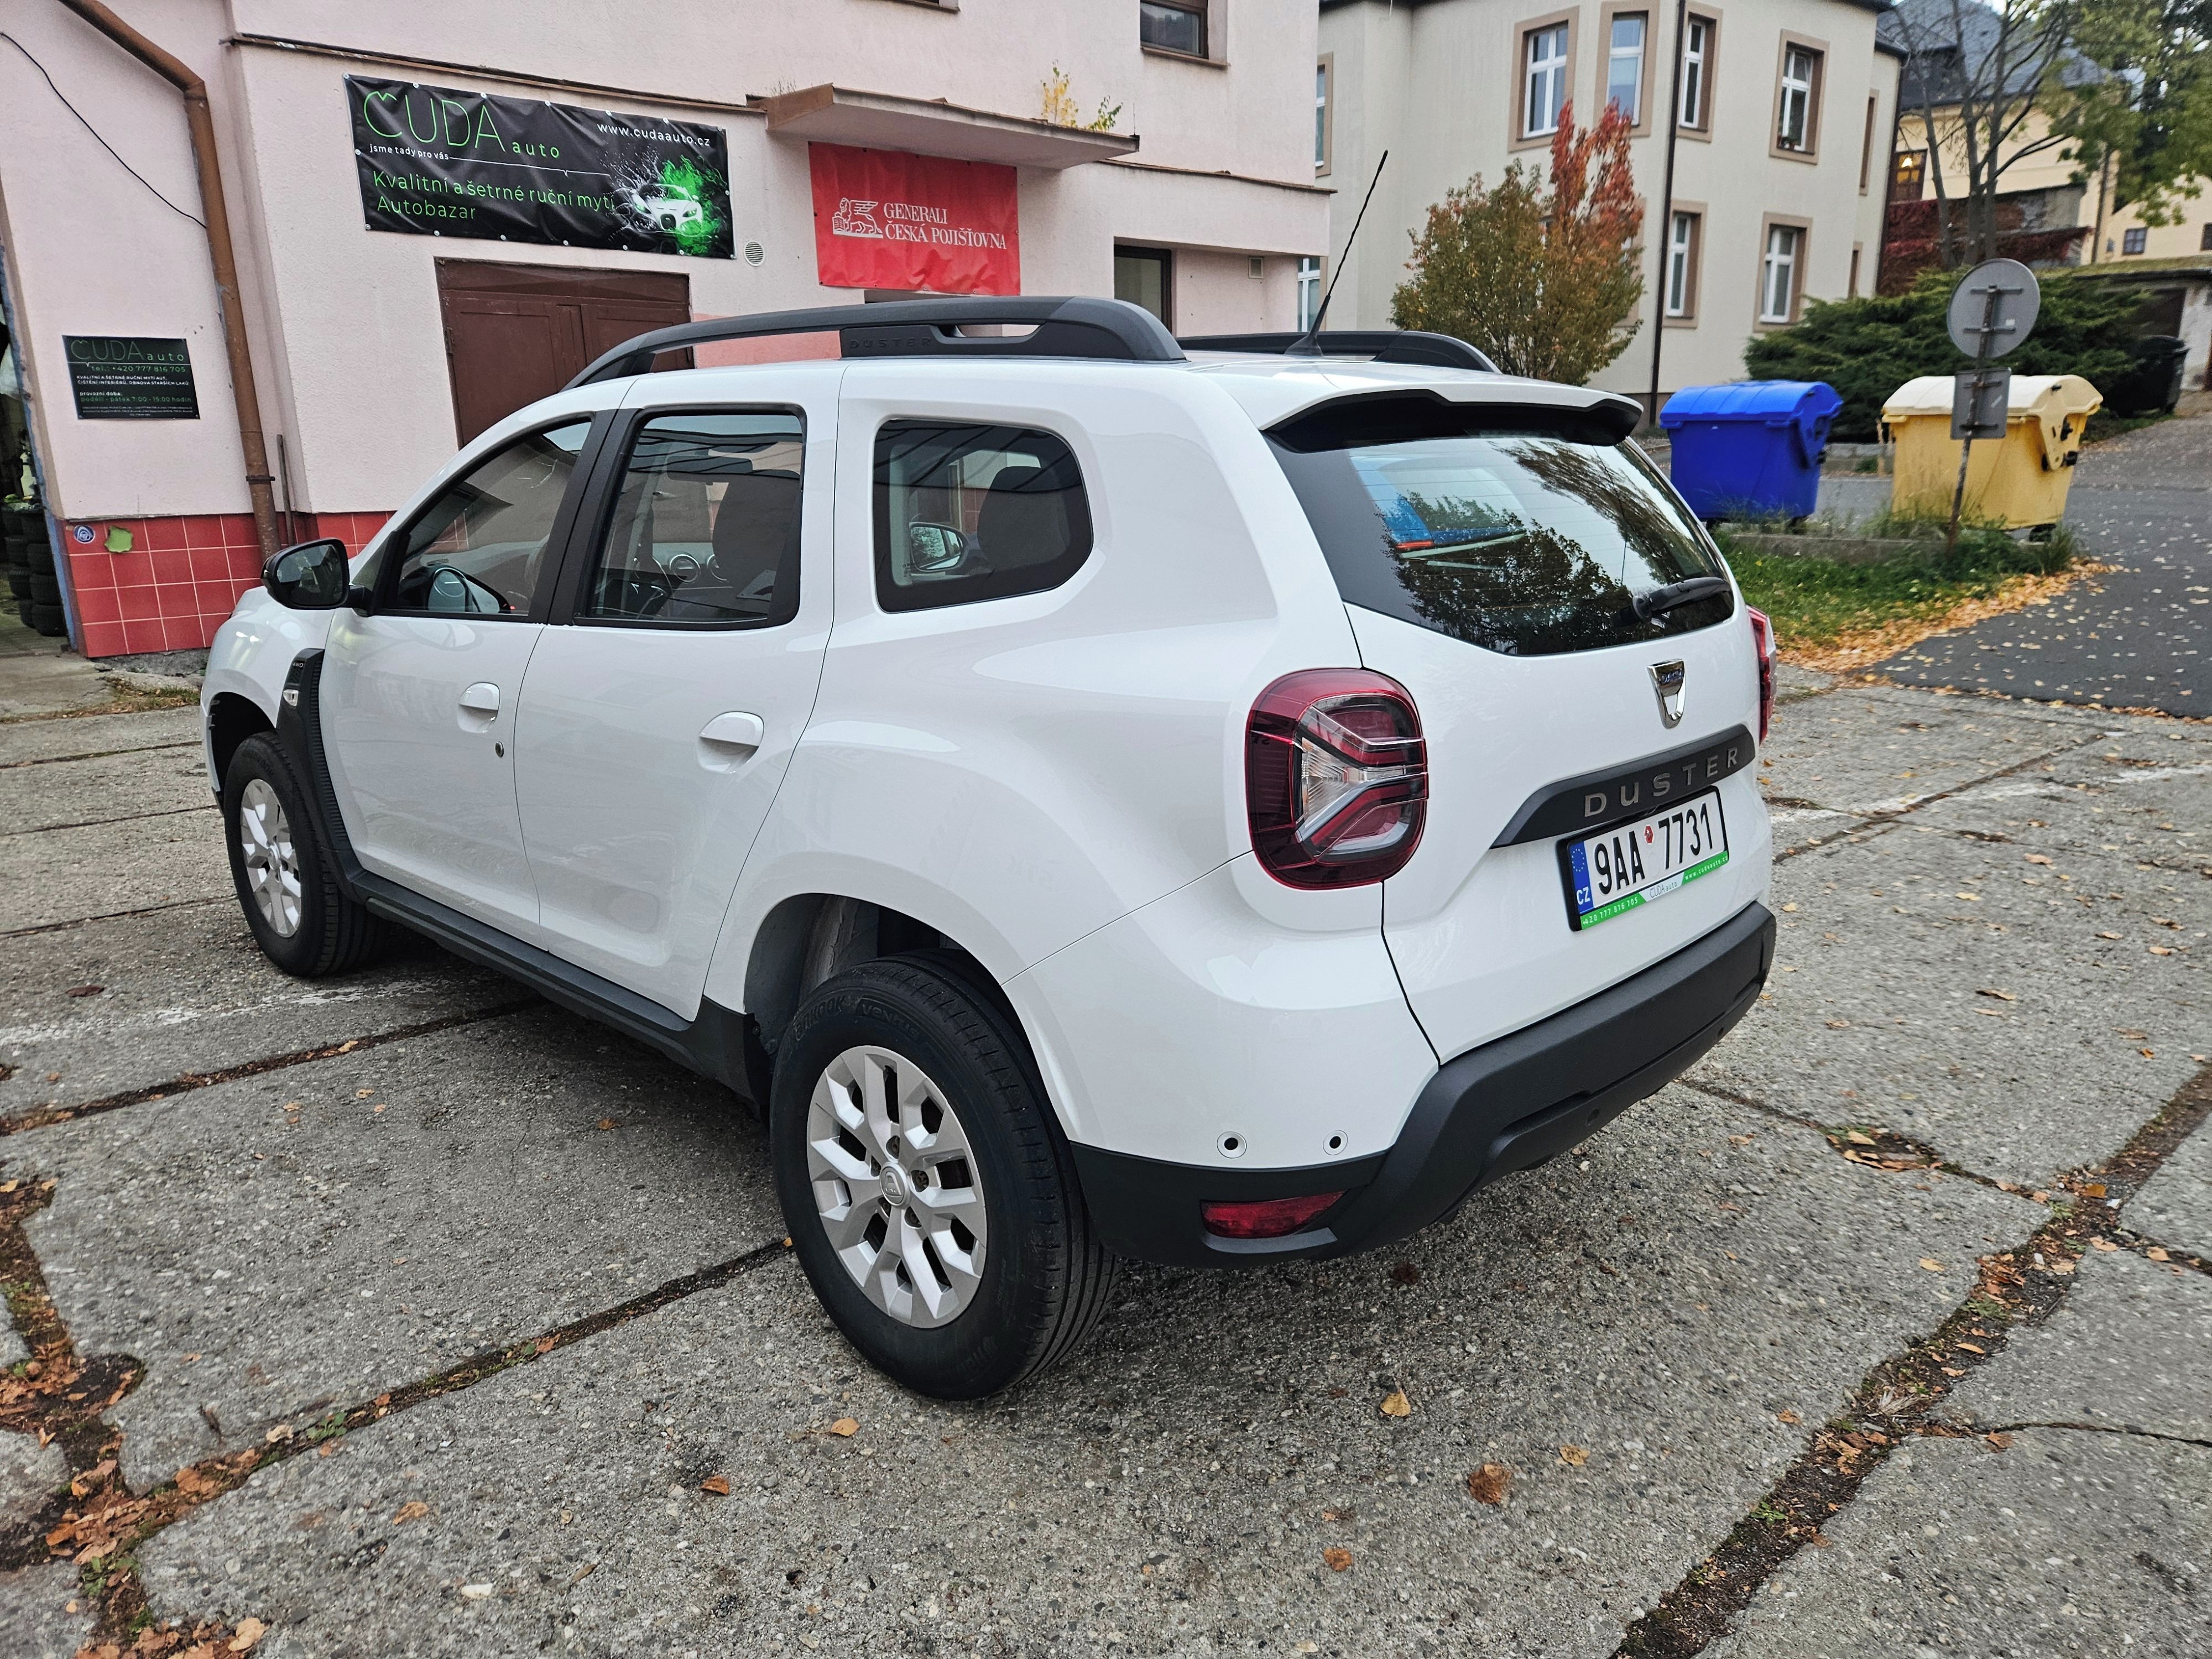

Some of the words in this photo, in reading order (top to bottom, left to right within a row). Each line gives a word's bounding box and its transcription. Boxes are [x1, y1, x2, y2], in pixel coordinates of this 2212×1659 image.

[597, 123, 711, 147] www.cudaauto.cz
[369, 144, 396, 154] jsme
[395, 146, 415, 156] tady
[418, 150, 431, 159] pro
[433, 151, 449, 160] vás
[512, 140, 560, 159] auto
[373, 170, 448, 193] Kvalitní
[453, 182, 463, 195] a
[467, 180, 524, 202] šetrné
[529, 187, 573, 206] ruční
[377, 195, 476, 220] Autobazar
[883, 202, 948, 225] GENERALI
[885, 220, 929, 243] ČESKÁ
[931, 227, 1007, 250] POJIŠŤOVNA
[849, 337, 931, 349] DUSTER
[147, 353, 184, 362] auto
[1584, 747, 1739, 818] DUSTER
[1594, 830, 1646, 895] 9AA
[1658, 802, 1714, 870] 7731
[1576, 886, 1591, 906] CZ
[1599, 907, 1612, 919] 777
[1614, 902, 1625, 913] 816
[1627, 896, 1639, 907] 705
